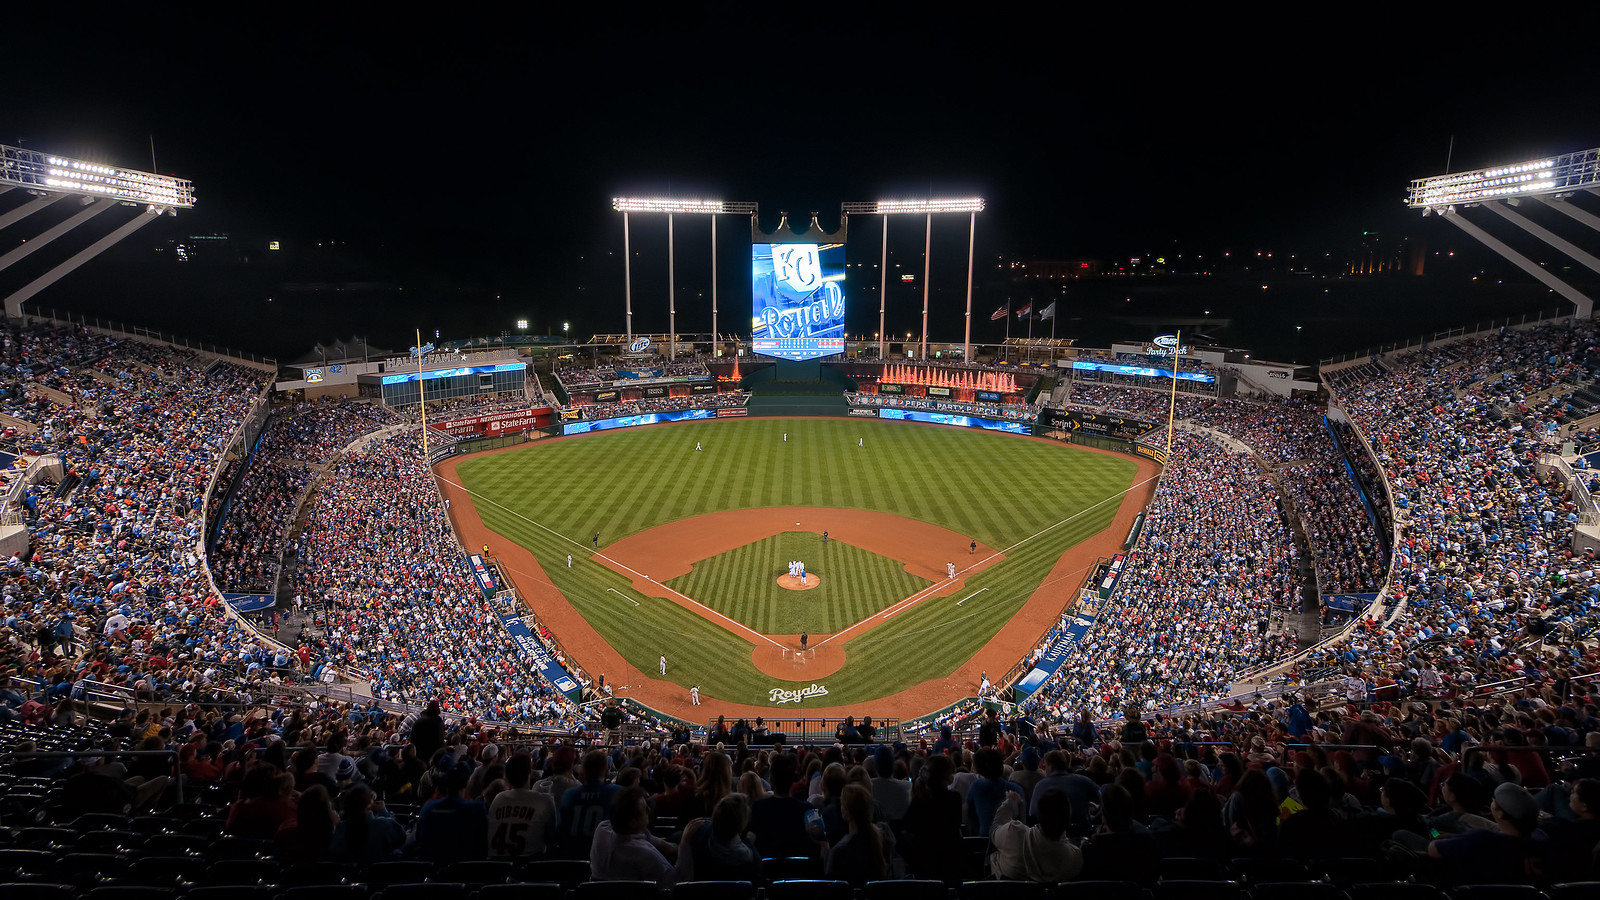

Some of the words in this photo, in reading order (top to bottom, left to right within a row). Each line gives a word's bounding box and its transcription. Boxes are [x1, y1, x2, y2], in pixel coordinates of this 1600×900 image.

[778, 248, 816, 287] KC
[1146, 346, 1167, 357] Party
[1168, 346, 1188, 355] Dck
[386, 356, 419, 368] HALL
[330, 364, 343, 374] 42
[905, 400, 930, 409] PEPSI
[936, 402, 965, 412] PARTY
[1051, 418, 1072, 428] Sprint
[769, 683, 829, 705] Royals
[496, 805, 536, 820] GIBSON
[492, 822, 529, 855] 45
